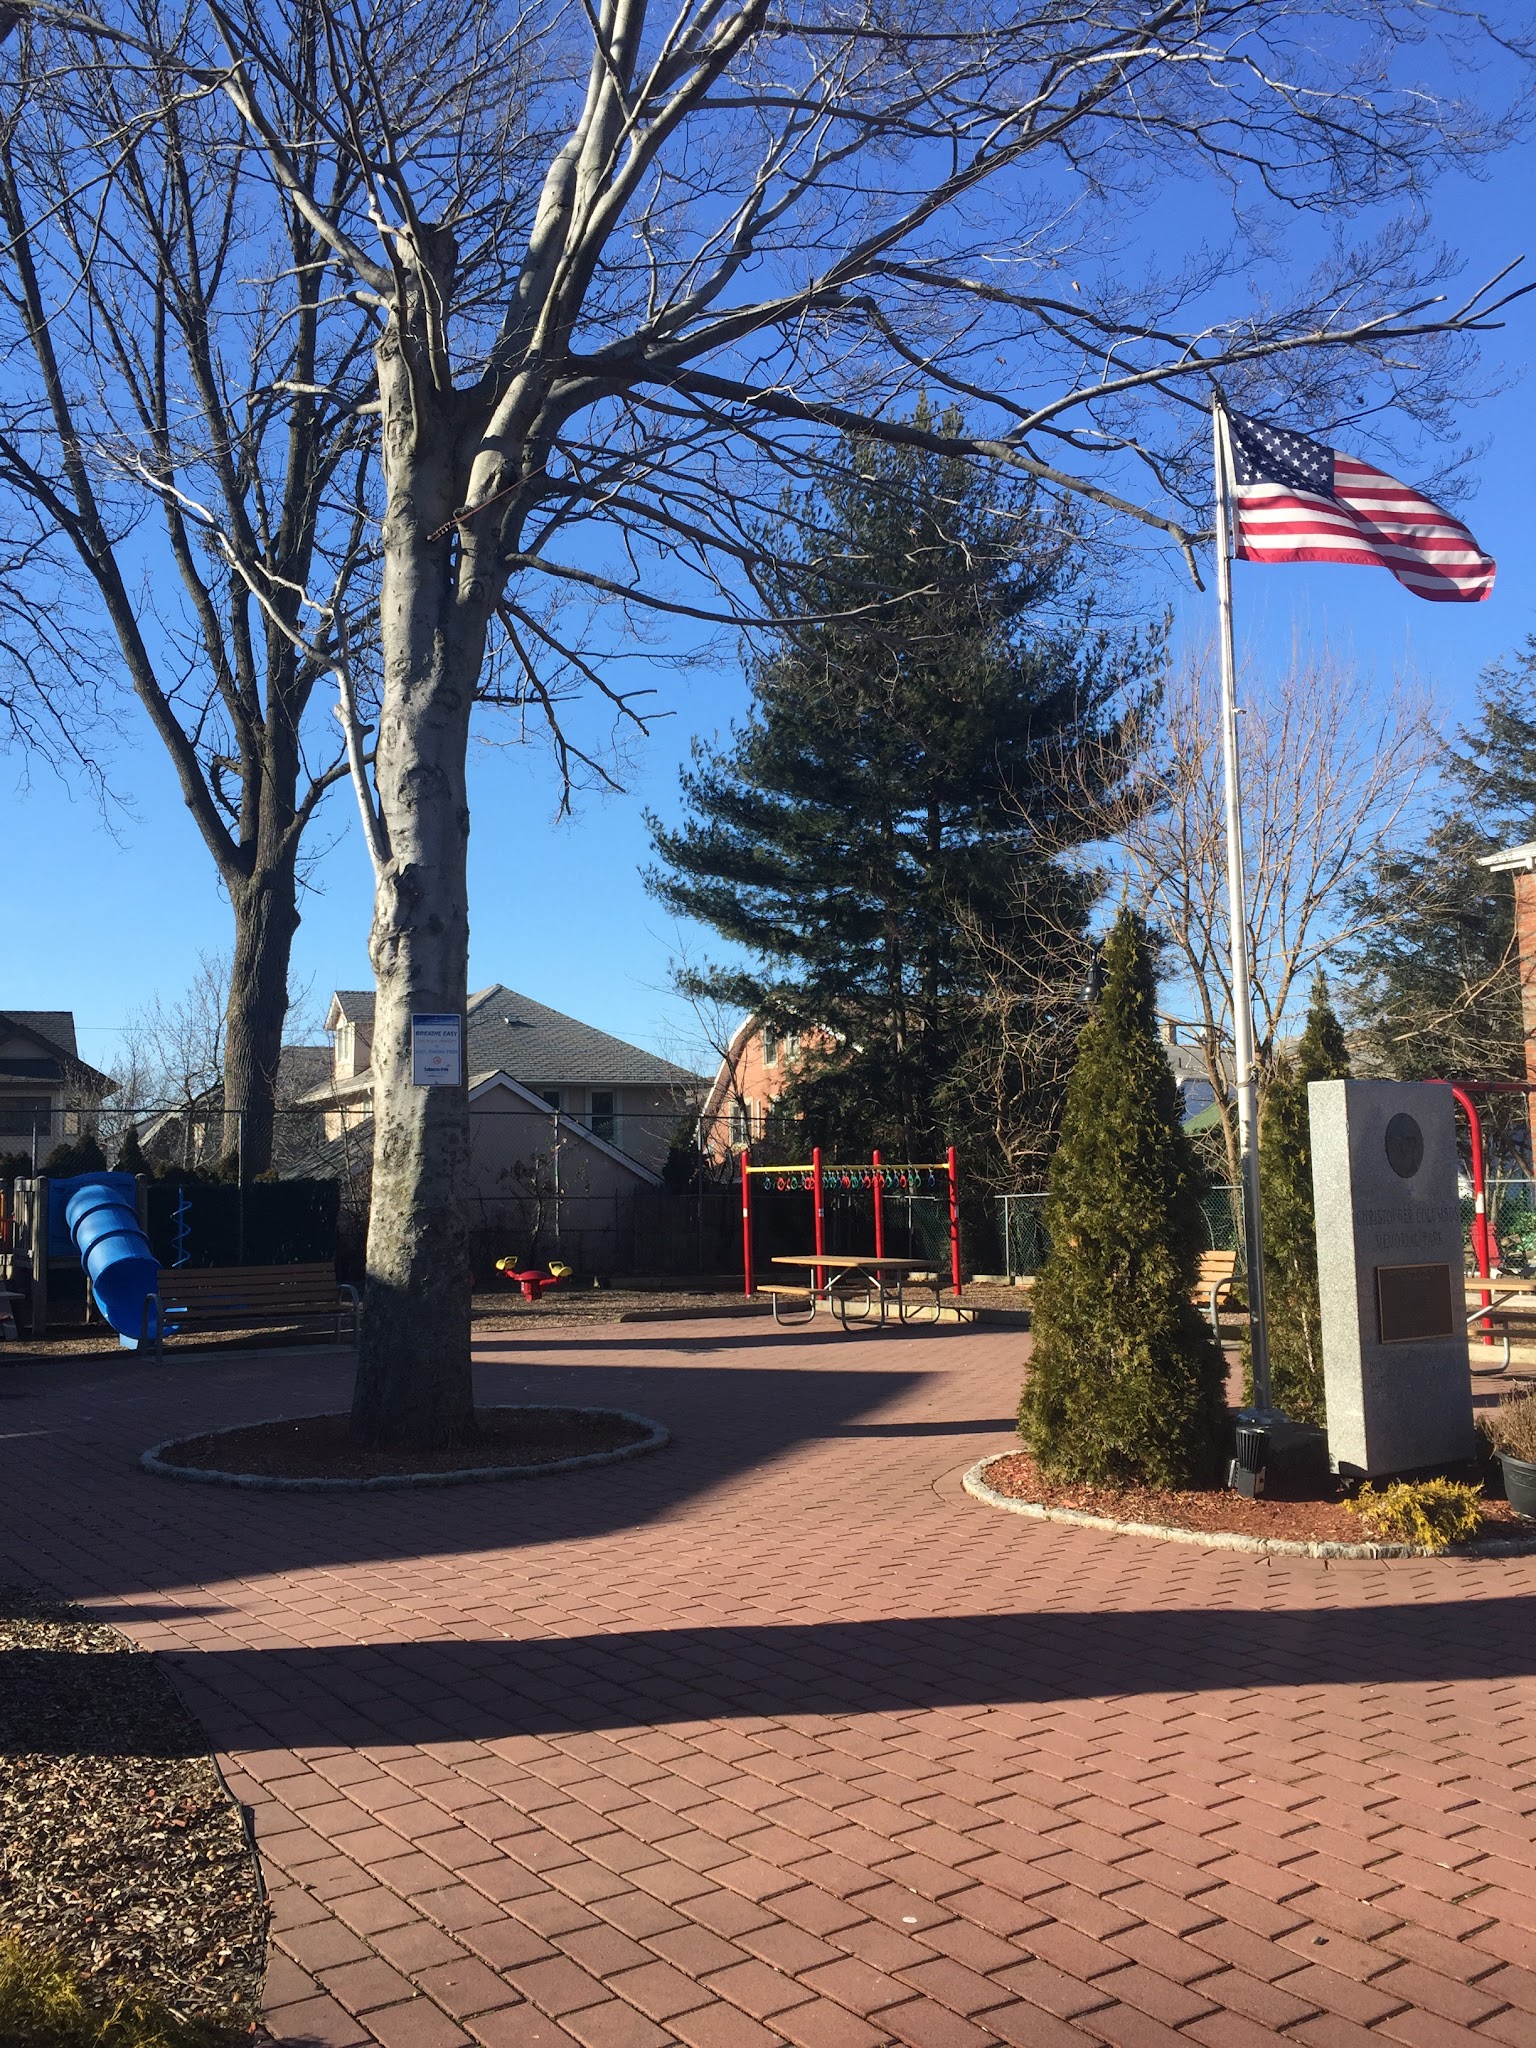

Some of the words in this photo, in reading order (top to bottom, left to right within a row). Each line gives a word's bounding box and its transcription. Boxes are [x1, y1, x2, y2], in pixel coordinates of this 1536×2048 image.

[1356, 1208, 1413, 1226] CHRISTOPHER
[1416, 1206, 1459, 1224] COLUMBUS
[1375, 1232, 1420, 1249] MEMORIAL
[1422, 1231, 1443, 1247] PARK
